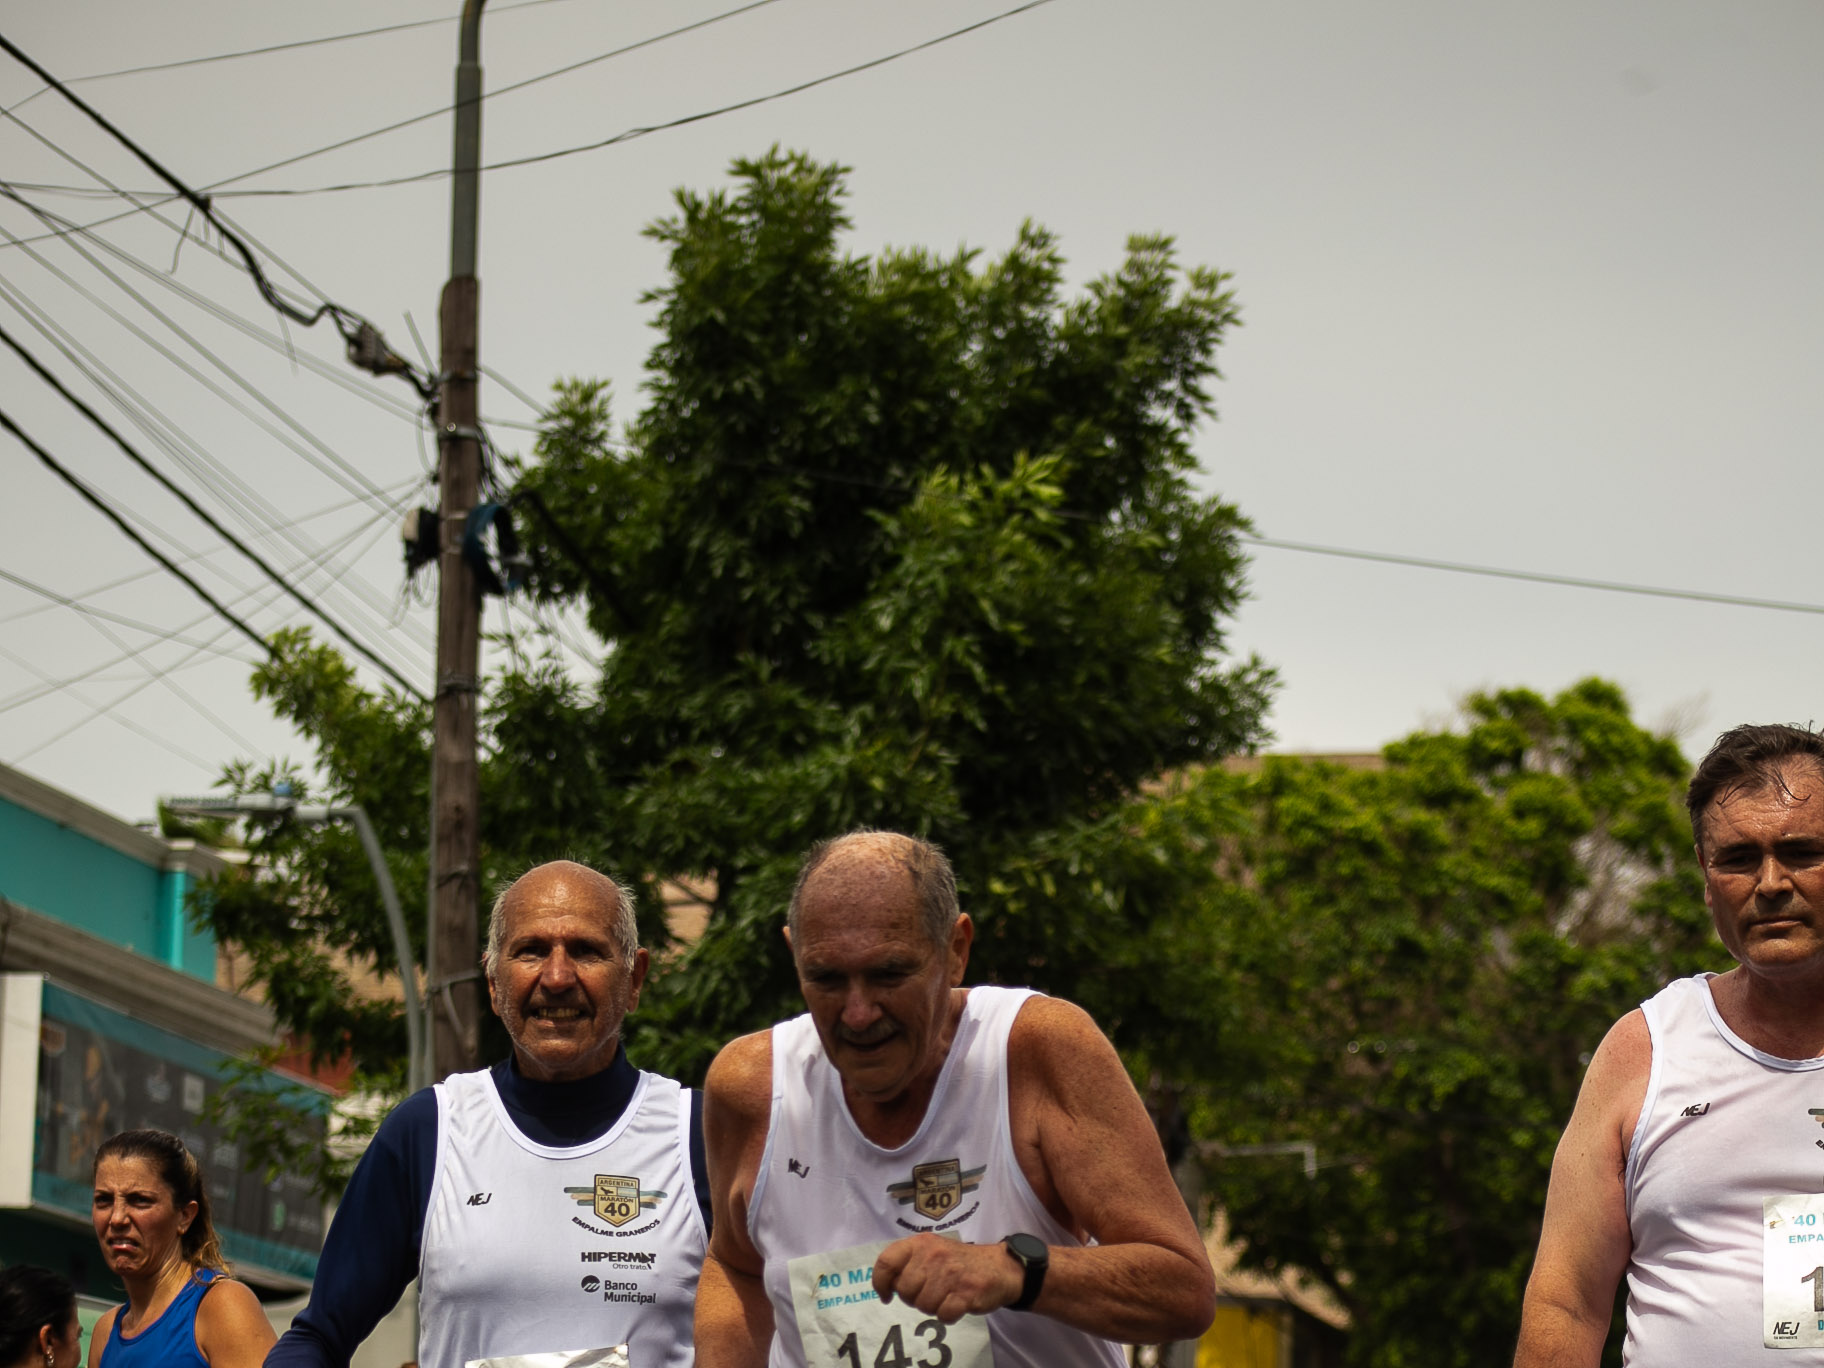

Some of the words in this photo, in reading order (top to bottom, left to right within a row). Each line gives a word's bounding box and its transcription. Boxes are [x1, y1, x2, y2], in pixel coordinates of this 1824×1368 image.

[1680, 1102, 1710, 1117] NEJ
[599, 1179, 634, 1188] ARGENTINA
[466, 1192, 492, 1206] NEJ
[924, 1192, 953, 1210] 40
[603, 1202, 631, 1217] 40
[571, 1216, 614, 1237] EMPALME
[616, 1218, 661, 1237] GRANEROS
[1794, 1213, 1816, 1226] 40
[604, 1280, 638, 1291] Banco
[817, 1272, 842, 1289] 40
[604, 1292, 656, 1305] Municipal
[1772, 1321, 1800, 1336] NEJ
